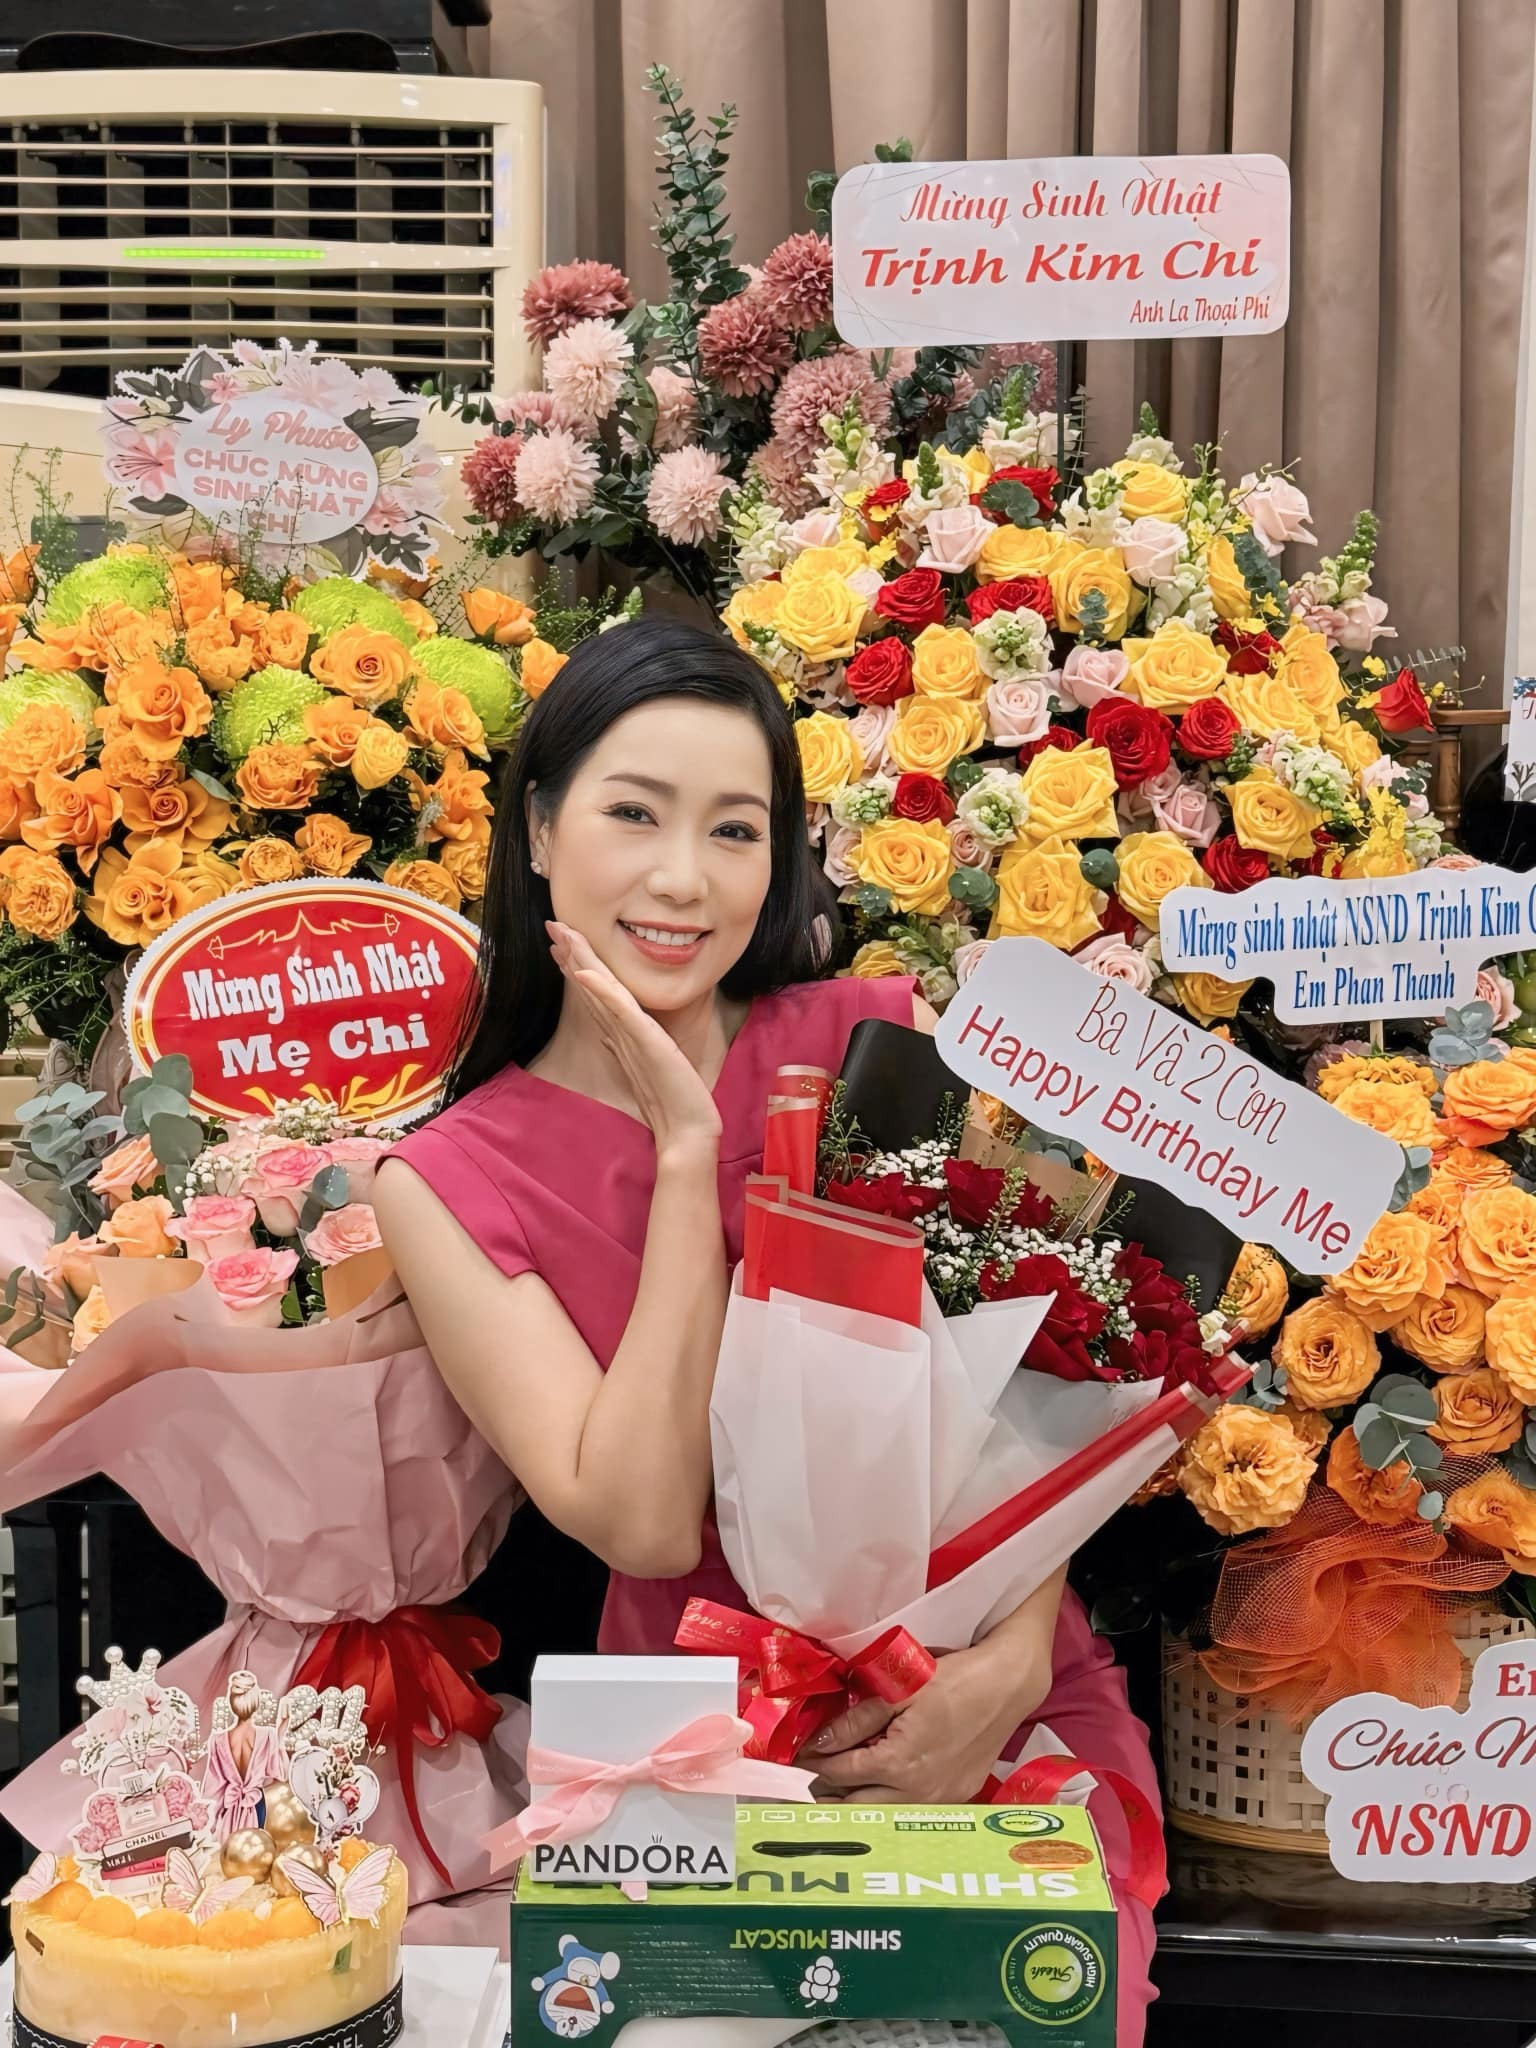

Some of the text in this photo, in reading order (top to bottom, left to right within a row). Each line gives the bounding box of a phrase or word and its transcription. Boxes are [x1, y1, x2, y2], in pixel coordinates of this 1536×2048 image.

[900, 177, 1224, 230] Mừng Sinh Nhật
[861, 238, 1263, 296] Trịnh Kim Chi
[1130, 295, 1271, 327] Anh La Thoại Phi
[193, 475, 266, 504] SINH
[1176, 906, 1238, 971] Mừng
[1243, 902, 1286, 954] sinh
[1292, 898, 1338, 964] nhật
[1343, 893, 1410, 948] NSND
[1416, 888, 1473, 955] Trịnh
[1479, 885, 1520, 937] Kim
[182, 939, 446, 1025] Mừng Sinh Nhật
[1293, 960, 1456, 1010] Em Phan Thanh
[217, 1012, 431, 1078] Mẹ Chi
[1075, 981, 1289, 1146] Ba Và 2 Con
[956, 1004, 1352, 1262] Happy Birthday Mẹ
[1328, 1718, 1467, 1772] Chúc
[125, 1830, 168, 1849] CHANEL
[1351, 1802, 1532, 1858] NSND
[535, 1842, 729, 1875] PANDORA
[862, 1871, 1080, 1898] SHINE
[730, 1929, 828, 1950] MUSCAT
[831, 1929, 902, 1951] SHINE
[1022, 1930, 1097, 1989] HIGH SUGAR QUALITY
